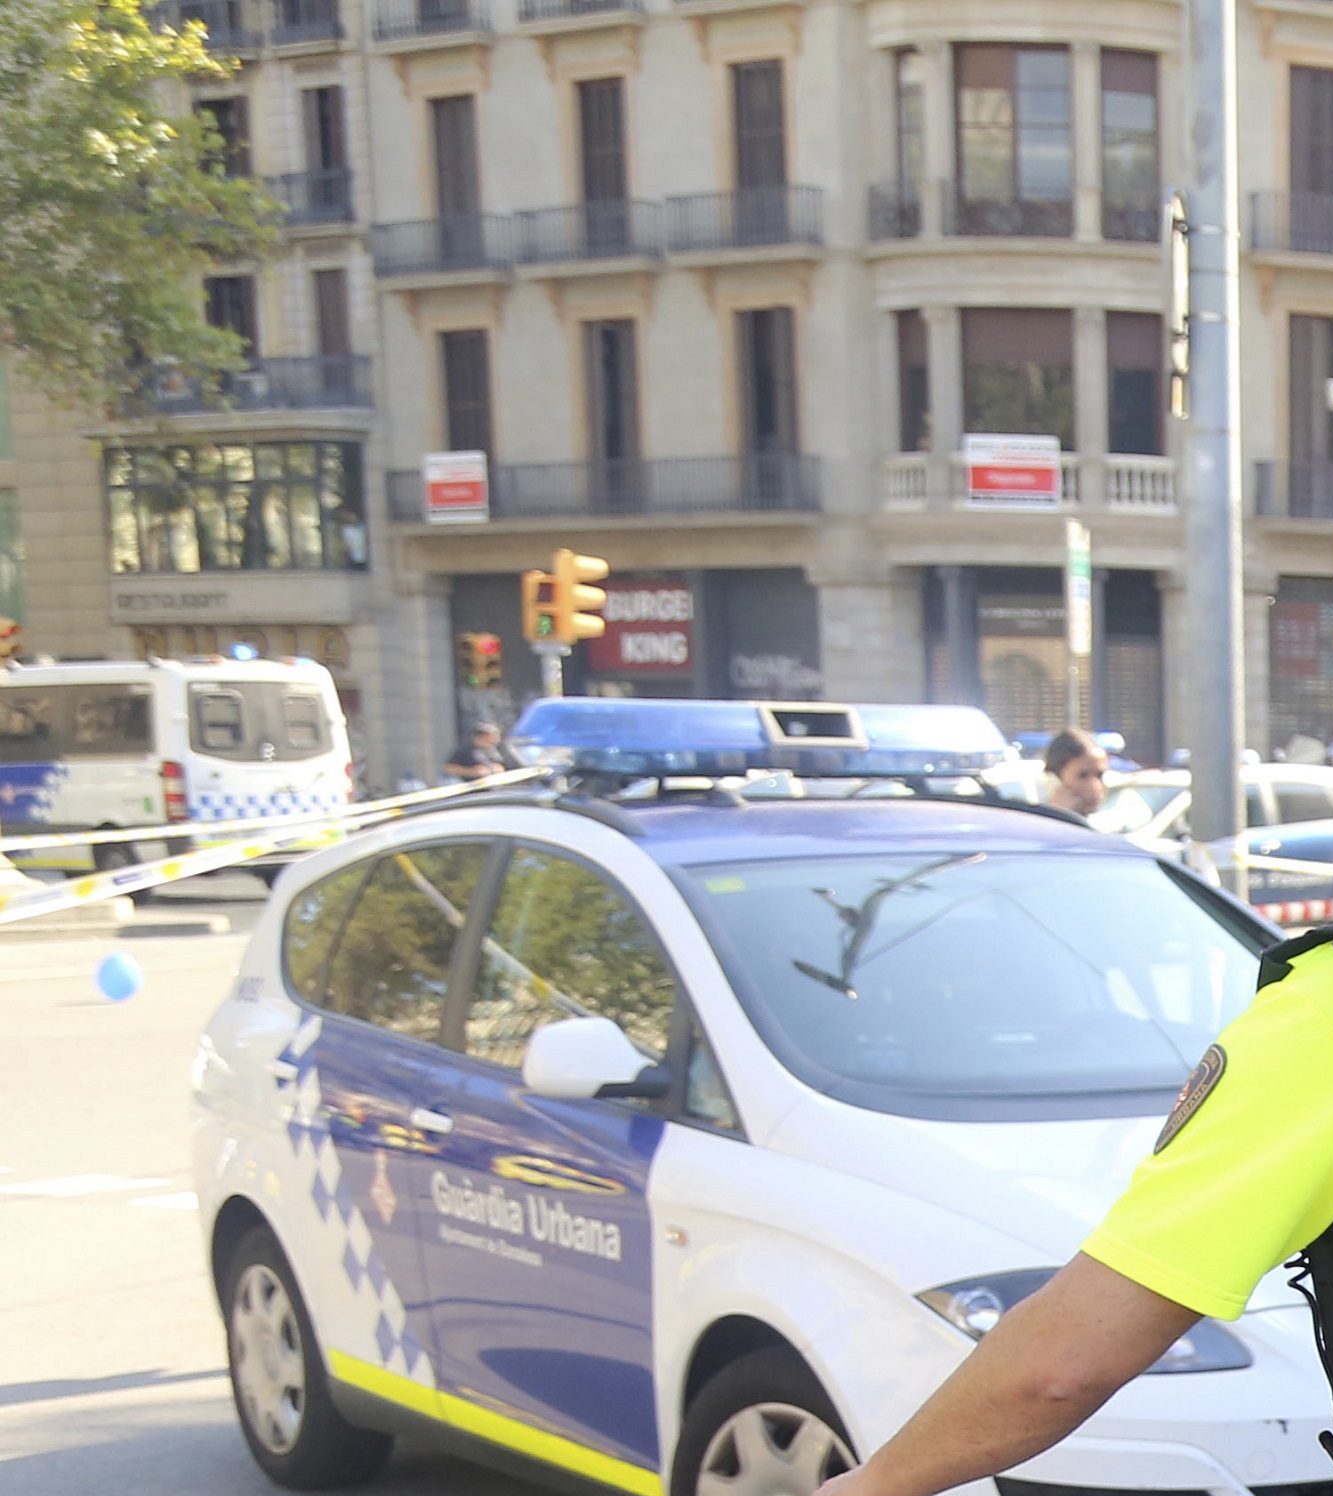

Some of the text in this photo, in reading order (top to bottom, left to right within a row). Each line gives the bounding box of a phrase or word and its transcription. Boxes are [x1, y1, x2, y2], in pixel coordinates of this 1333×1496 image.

[620, 631, 688, 665] KING
[431, 1170, 525, 1235] Guàrdia
[526, 1193, 623, 1262] Urbana
